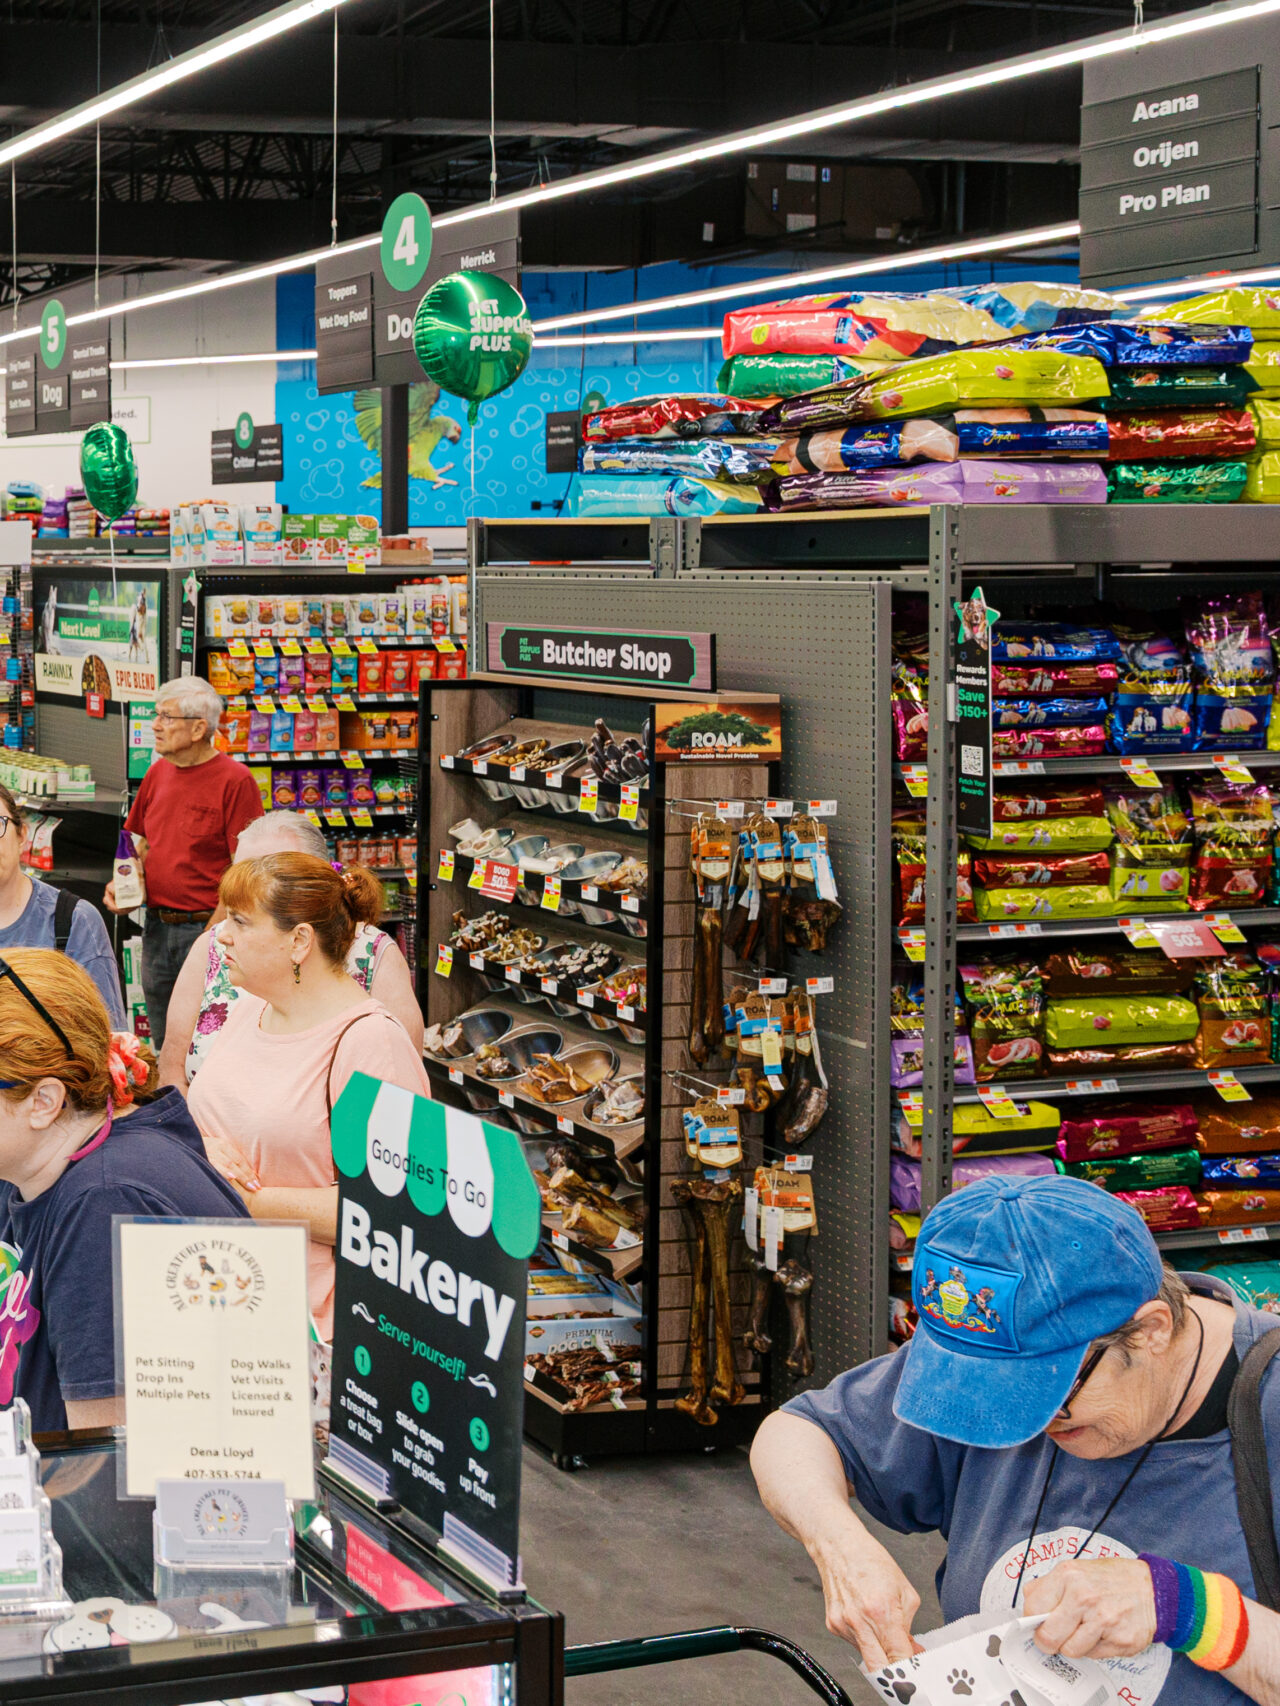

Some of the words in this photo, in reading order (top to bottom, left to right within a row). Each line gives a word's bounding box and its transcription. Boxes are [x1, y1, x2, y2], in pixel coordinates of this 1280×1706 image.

[1133, 90, 1199, 122] Acana
[1133, 136, 1199, 168] Orijen
[1119, 190, 1156, 215] Pro
[1160, 181, 1211, 209] Plan
[393, 215, 419, 265] 4
[460, 250, 495, 269] Merrick
[328, 284, 357, 300] Toppers
[319, 315, 333, 329] Wet
[334, 312, 349, 328] Dog
[349, 307, 368, 322] Food
[47, 315, 59, 352] 5
[470, 335, 512, 351] PLUS
[42, 384, 62, 407] Dog
[240, 419, 250, 440] 8
[61, 621, 80, 637] Next
[80, 622, 101, 637] Level
[543, 638, 616, 669] Butcher
[620, 643, 671, 679] Shop
[957, 664, 987, 675] Rewards
[115, 670, 133, 688] EPIC
[134, 672, 155, 691] BLEND
[956, 675, 987, 687] Members
[958, 688, 985, 702] Save
[956, 705, 988, 718] $150+
[691, 732, 742, 748] ROAM
[680, 752, 714, 760] Sustainable
[715, 752, 733, 760] Novel
[733, 752, 759, 760] Proteins
[704, 1115, 729, 1123] ROAM
[372, 1138, 434, 1185] Goodies
[440, 1167, 457, 1195] To
[464, 1180, 486, 1208] Go
[167, 1241, 208, 1290] CREATURES
[211, 1240, 235, 1251] PET
[236, 1247, 266, 1292] SERVICES
[340, 1197, 516, 1362] Bakery
[377, 1313, 410, 1347] Serve
[412, 1336, 467, 1381] yourself!
[548, 1340, 578, 1354] DOG
[135, 1357, 155, 1367] Pet
[157, 1358, 195, 1369] Sitting
[231, 1359, 254, 1370] Dog
[256, 1359, 291, 1369] Walks
[136, 1373, 164, 1385] Drop
[167, 1373, 184, 1384] Ins
[231, 1375, 250, 1385] Vet
[253, 1375, 283, 1385] Visits
[136, 1389, 184, 1400] Multiple
[187, 1390, 210, 1400] Pets
[232, 1390, 280, 1401] Licensed
[284, 1392, 292, 1401] &
[345, 1378, 378, 1409] Choose
[416, 1388, 426, 1405] 2
[232, 1407, 274, 1416] Insured
[340, 1396, 346, 1405] a
[346, 1396, 366, 1420] treat
[366, 1411, 382, 1434] bag
[347, 1419, 358, 1432] or
[359, 1423, 373, 1444] box
[396, 1410, 418, 1436] Slide
[419, 1428, 444, 1453] open
[475, 1424, 484, 1441] 3
[190, 1447, 219, 1457] Dena
[223, 1447, 254, 1459] Lloyd
[403, 1435, 413, 1450] to
[414, 1442, 435, 1466] grab
[392, 1448, 411, 1470] your
[412, 1458, 446, 1494] goodies
[469, 1457, 489, 1484] Pay
[459, 1475, 472, 1492] up
[473, 1481, 497, 1509] front
